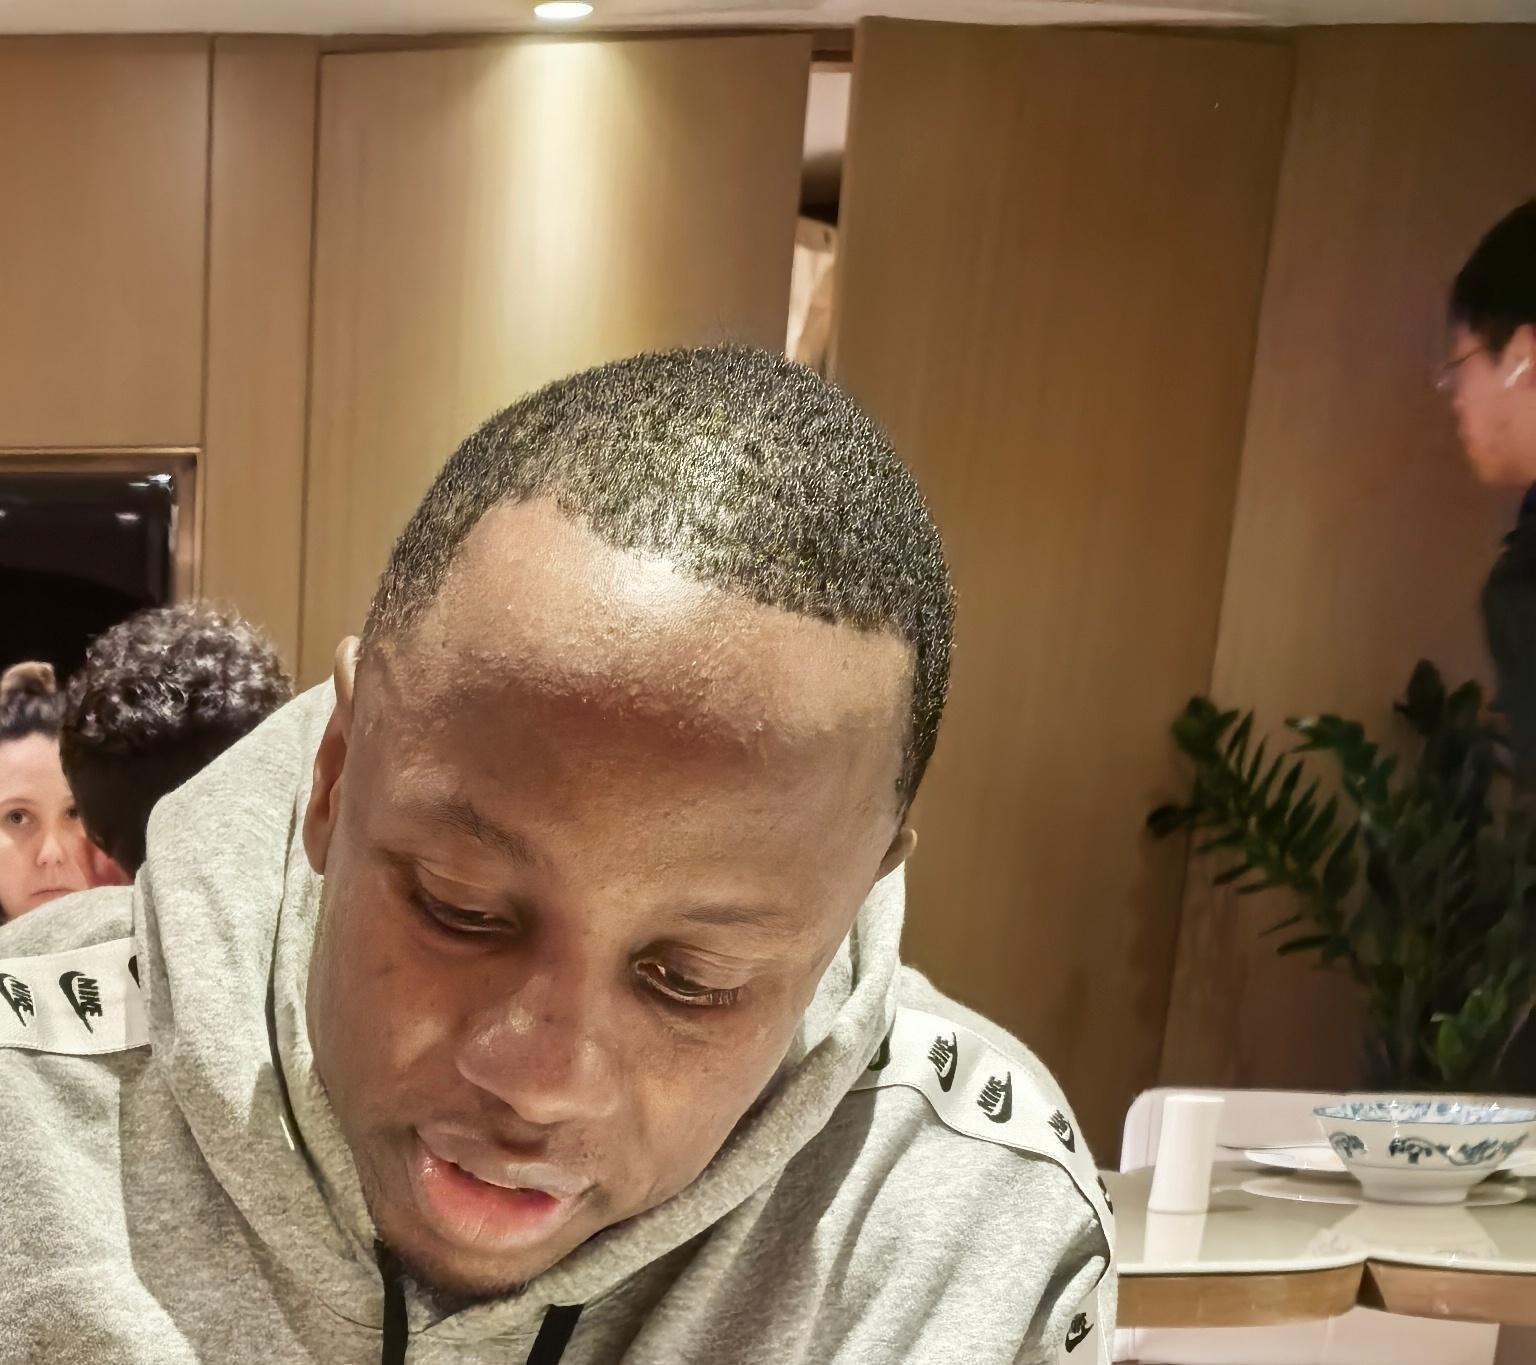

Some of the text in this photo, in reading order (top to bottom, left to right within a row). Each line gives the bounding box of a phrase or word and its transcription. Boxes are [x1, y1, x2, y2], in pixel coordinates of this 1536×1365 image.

[9, 978, 34, 1017] NIKE
[78, 977, 103, 1017] NIKE
[928, 1035, 949, 1071] NIKE
[976, 1075, 1005, 1114] NIKE
